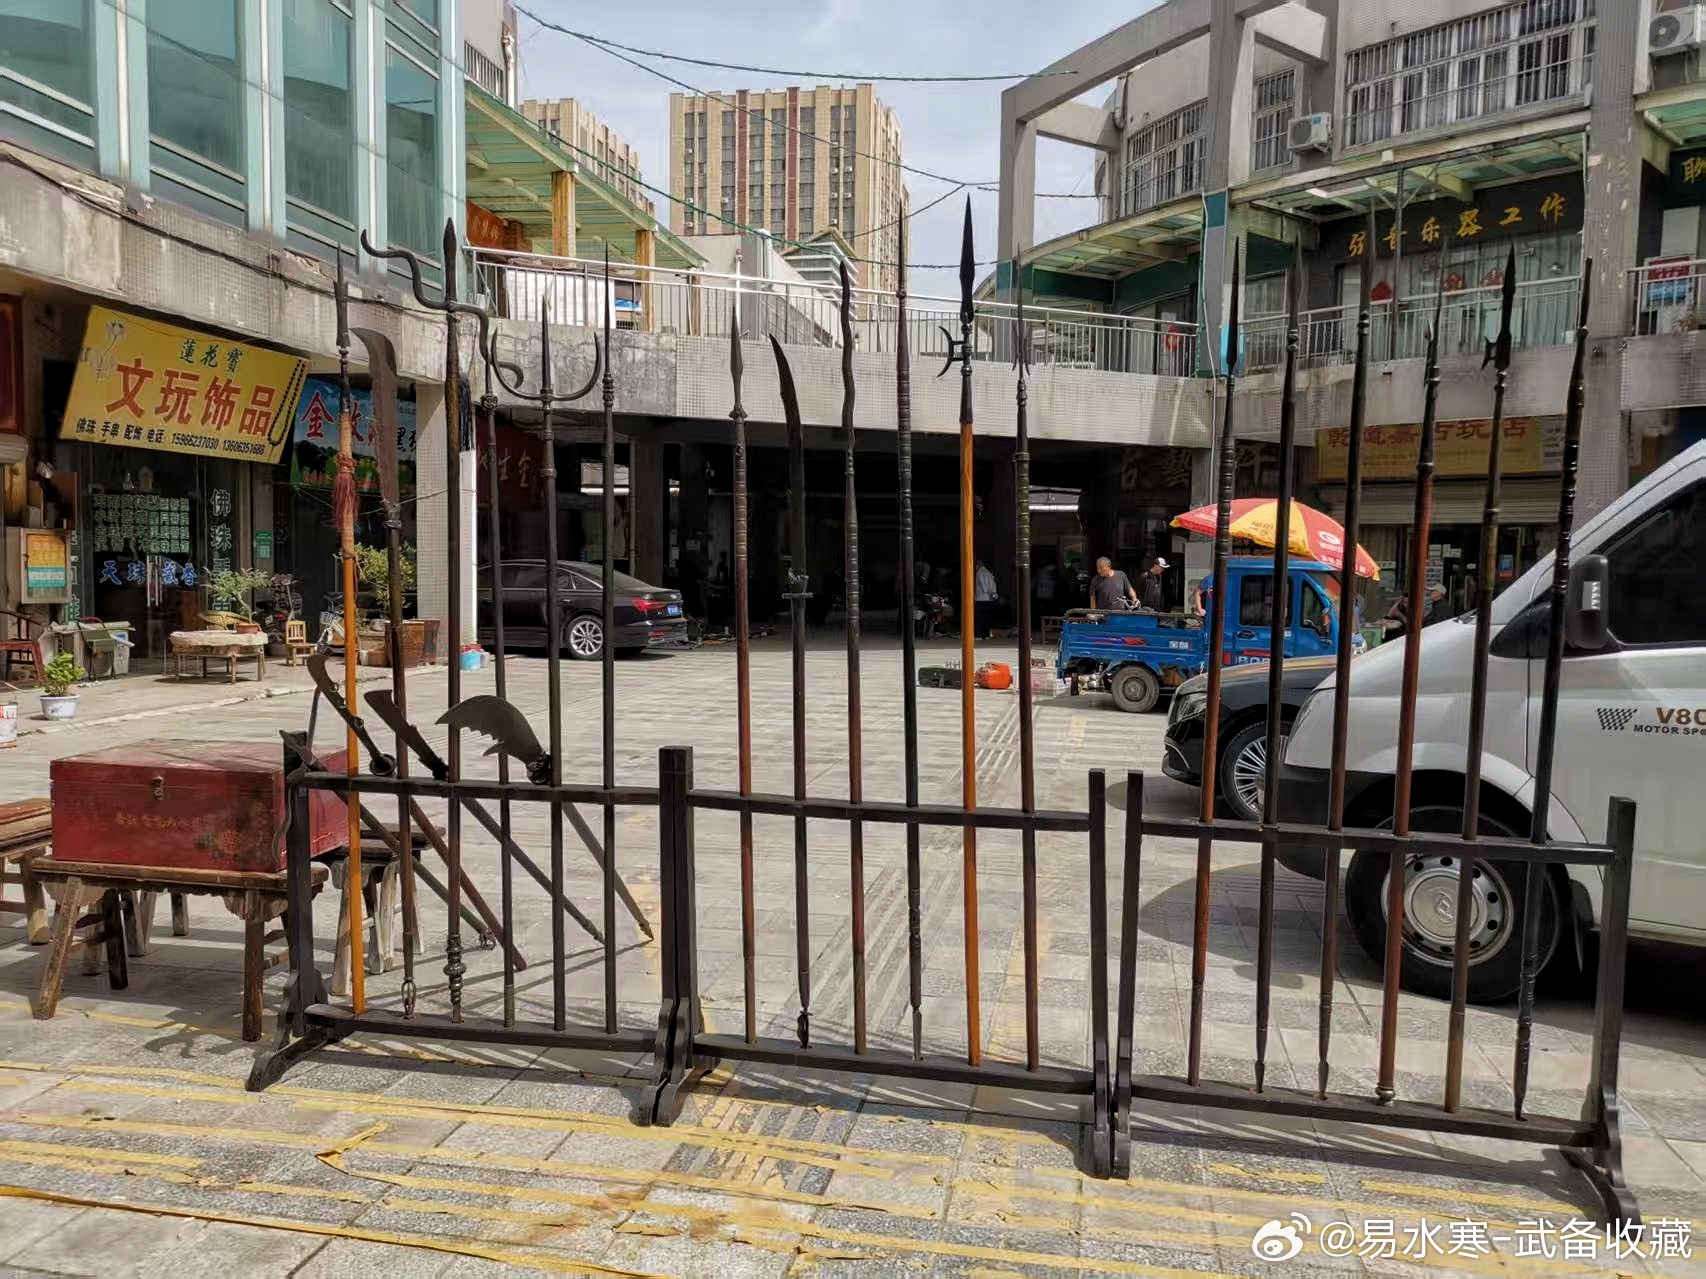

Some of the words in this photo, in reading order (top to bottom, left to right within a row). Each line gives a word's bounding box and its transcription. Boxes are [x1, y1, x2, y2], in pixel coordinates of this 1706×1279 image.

[104, 357, 276, 438] 文玩饰品
[76, 418, 97, 434] 佛珠
[100, 421, 120, 438] 手串
[146, 428, 165, 444] 电话
[1633, 724, 1680, 735] MOTOR
